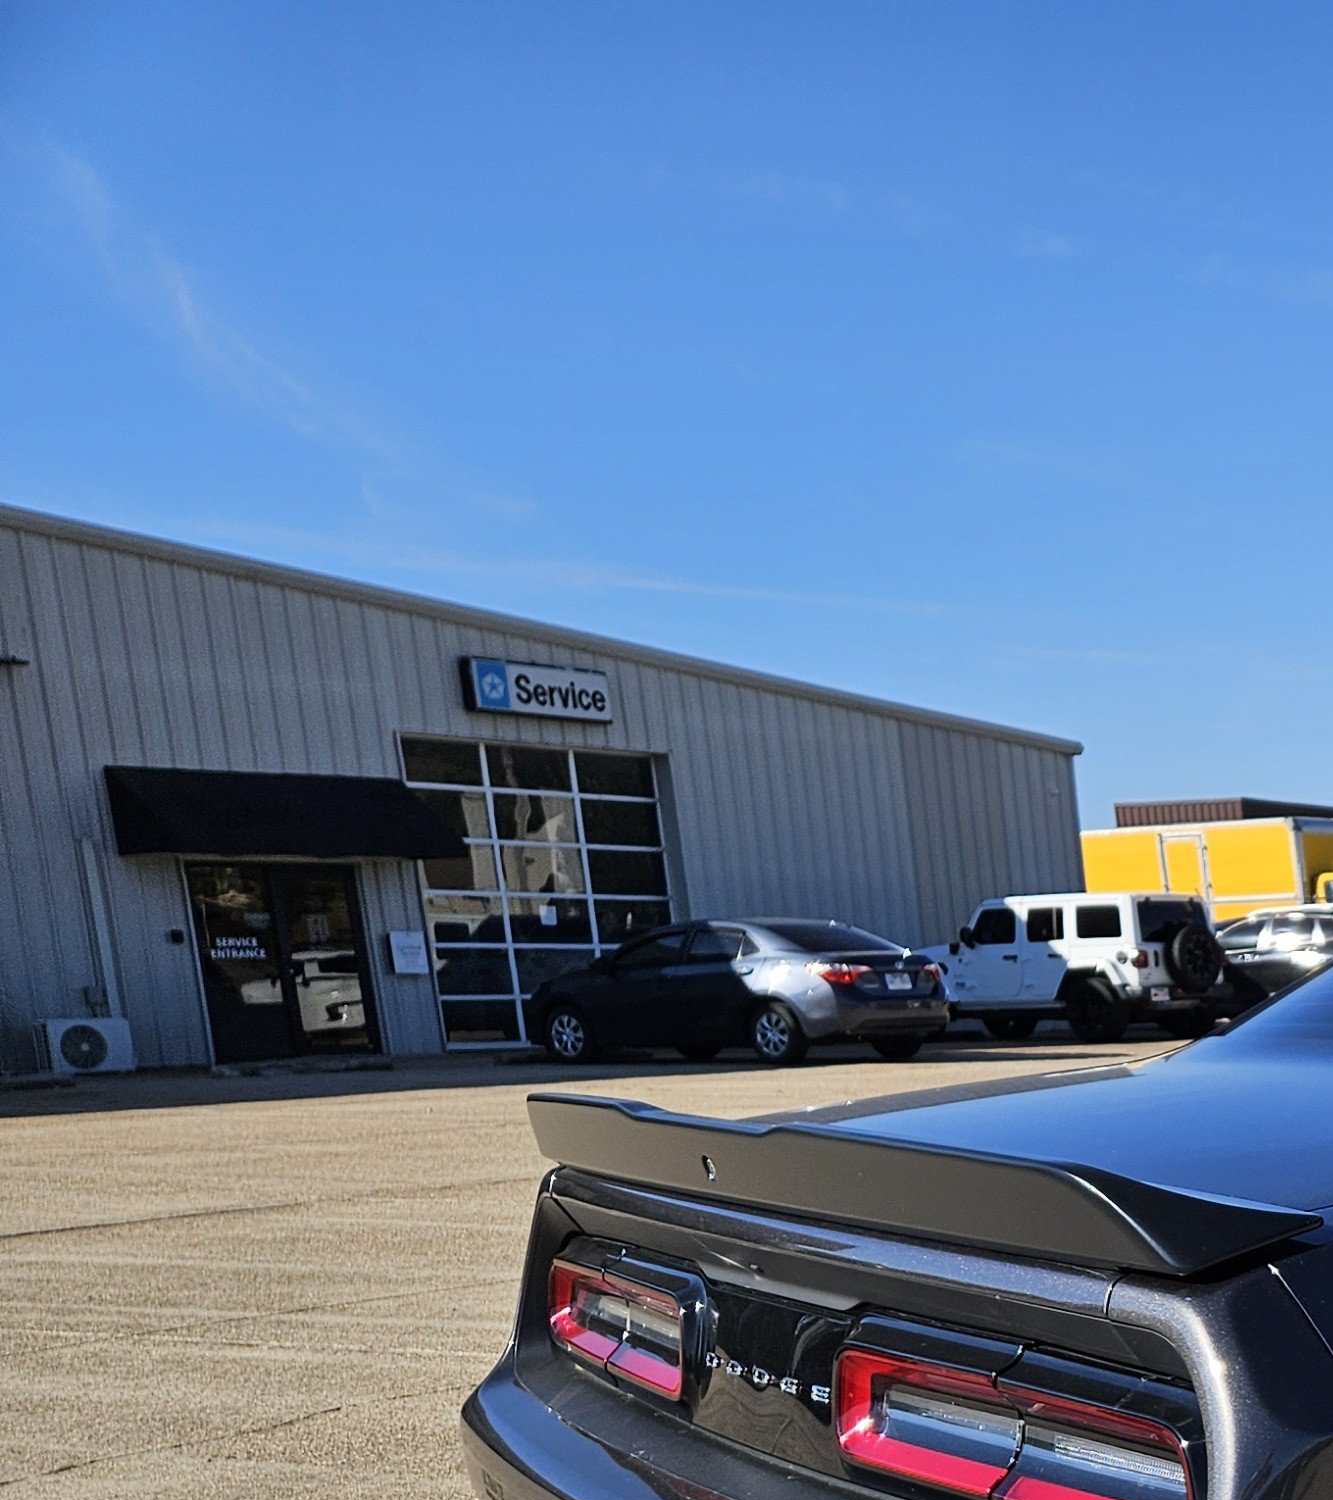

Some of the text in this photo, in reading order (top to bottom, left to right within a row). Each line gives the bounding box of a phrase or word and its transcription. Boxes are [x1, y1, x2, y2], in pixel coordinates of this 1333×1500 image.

[514, 672, 606, 712] Service
[211, 948, 267, 959] ENTRANCE
[215, 936, 258, 948] SERVICE
[705, 1351, 831, 1405] DODGE
